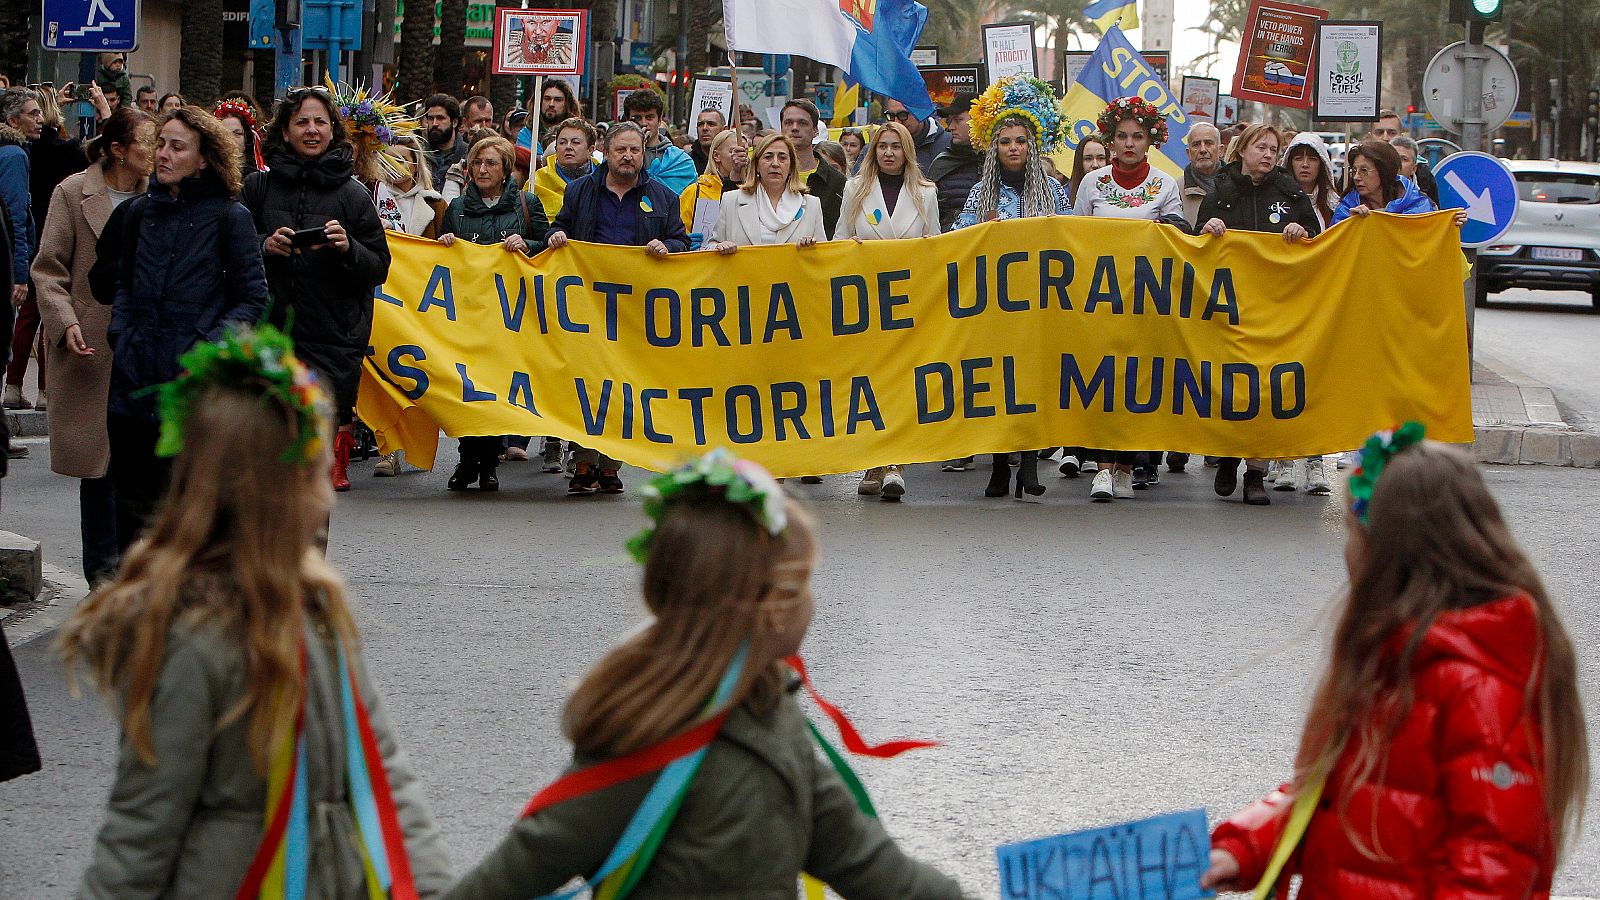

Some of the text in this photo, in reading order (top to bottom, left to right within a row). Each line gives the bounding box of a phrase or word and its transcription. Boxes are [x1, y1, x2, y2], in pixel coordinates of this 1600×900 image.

[1260, 20, 1303, 35] VETO POWER
[999, 39, 1016, 51] HALT
[1266, 32, 1280, 42] THE
[1280, 34, 1305, 45] HANDS
[995, 49, 1028, 63] ATROCITY
[944, 75, 974, 83] WHO'S
[1102, 47, 1186, 125] STOP
[1332, 83, 1361, 95] FUELS
[494, 272, 803, 347] VICTORIA
[830, 269, 915, 337] DE
[945, 249, 1240, 326] UCRANIA
[365, 344, 1306, 446] S LA VICTORIA DEL MUNDO
